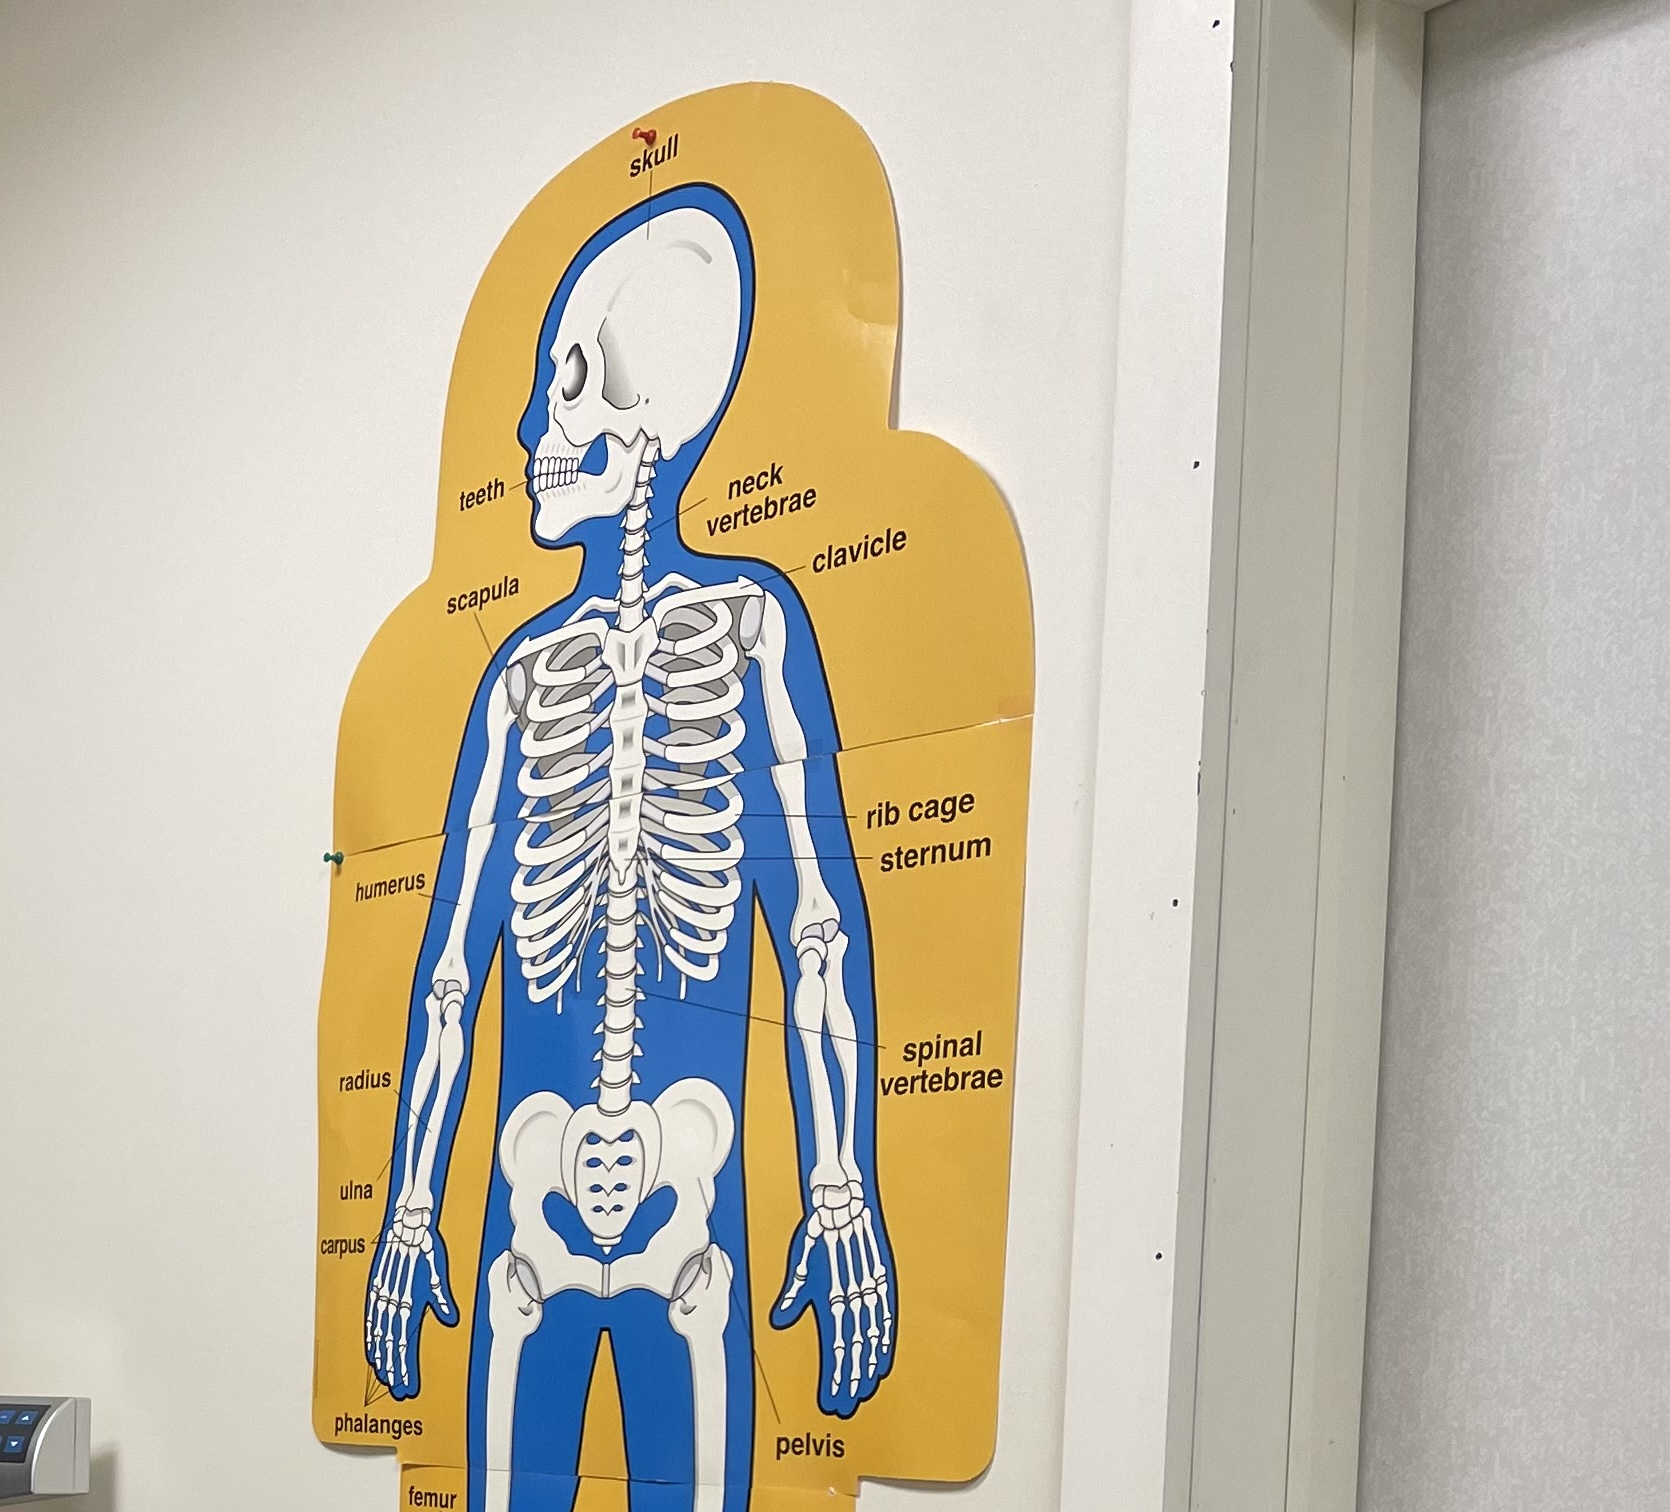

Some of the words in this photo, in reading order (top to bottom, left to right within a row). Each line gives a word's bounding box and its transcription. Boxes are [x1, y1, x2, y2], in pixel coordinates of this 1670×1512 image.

[630, 134, 678, 177] skull
[460, 478, 504, 511] teeth
[728, 463, 784, 500] neck
[706, 484, 817, 537] vertebrae
[813, 528, 906, 573] clavicle
[447, 576, 518, 614] scapula
[867, 802, 899, 829] rib
[909, 794, 974, 823] cage
[881, 838, 990, 872] sternum
[356, 874, 425, 901] humerus
[903, 1030, 982, 1065] spinal
[340, 1069, 390, 1091] radius
[880, 1065, 1004, 1099] vertebrae
[341, 1180, 372, 1200] ulna
[321, 1236, 365, 1257] carpus
[335, 1413, 422, 1439] phalanges
[777, 1432, 844, 1460] pelvis
[409, 1486, 457, 1509] femur
